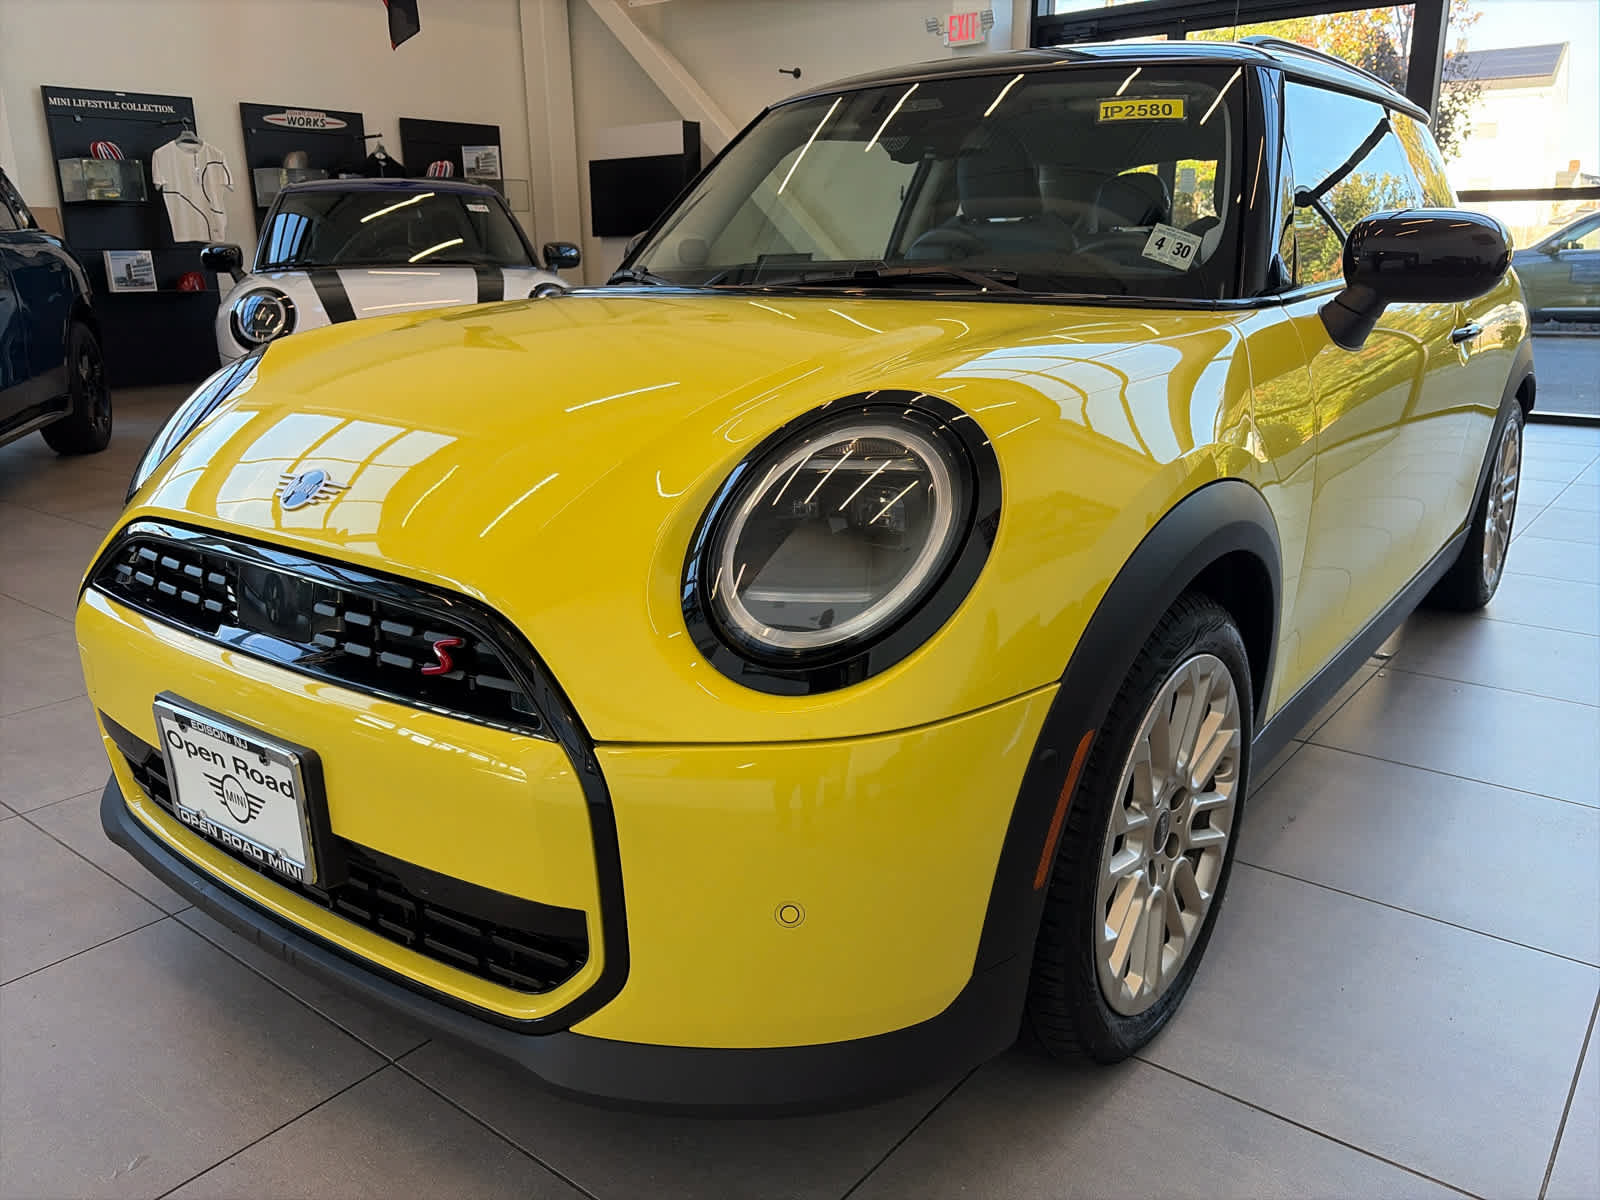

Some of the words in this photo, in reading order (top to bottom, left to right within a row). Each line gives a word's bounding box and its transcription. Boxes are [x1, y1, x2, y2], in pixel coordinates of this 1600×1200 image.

[948, 12, 978, 41] EXIT
[48, 97, 71, 106] MINI
[72, 99, 120, 110] LIFESTYLE
[1102, 103, 1173, 118] IP2580
[287, 116, 326, 127] WORKS
[1155, 237, 1166, 250] 4
[1172, 242, 1191, 258] 30
[421, 638, 461, 675] S
[233, 737, 248, 750] NJ
[166, 730, 226, 768] Open
[232, 756, 296, 800] Road
[225, 790, 247, 809] MINI
[180, 810, 217, 838] OPEN
[222, 831, 263, 860] ROAD
[268, 854, 304, 881] MINI
